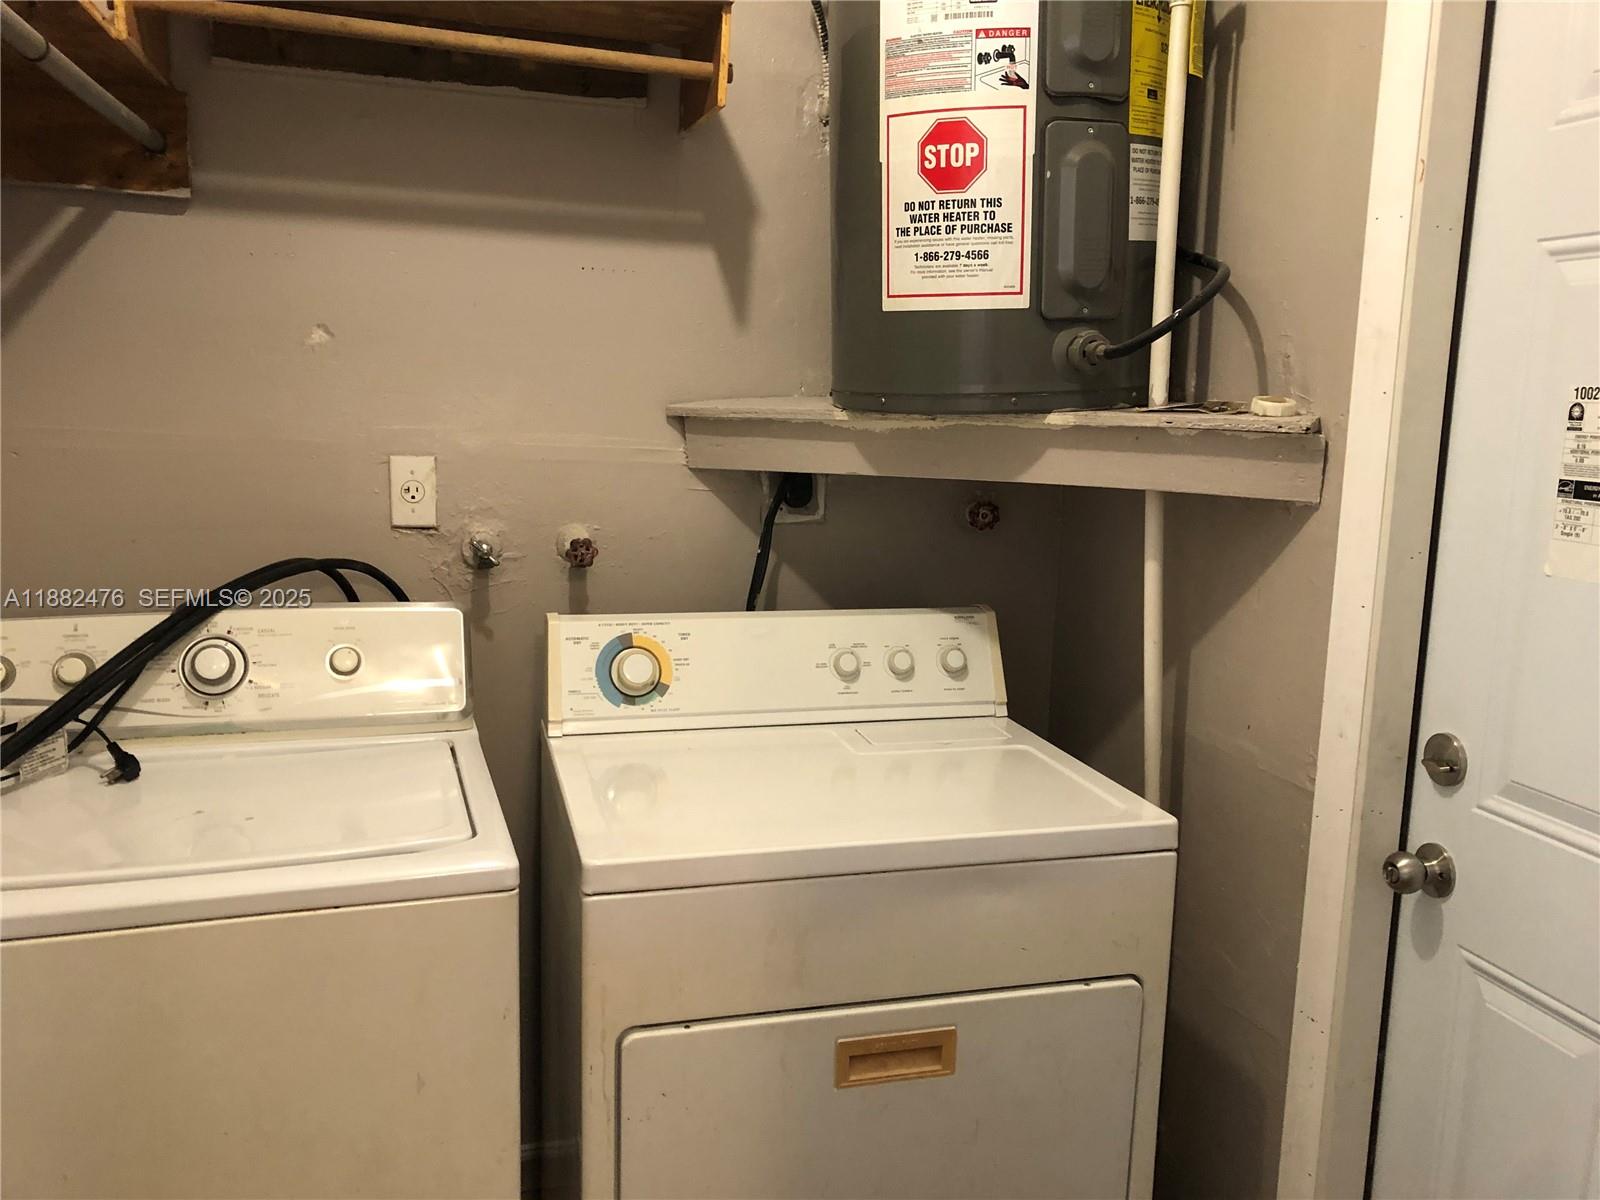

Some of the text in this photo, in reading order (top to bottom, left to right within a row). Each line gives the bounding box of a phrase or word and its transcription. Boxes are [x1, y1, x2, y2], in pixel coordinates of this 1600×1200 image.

[924, 142, 980, 170] STOP
[904, 198, 1002, 212] DO NOT RETURN THIS
[910, 210, 996, 224] WATER HEATER TO
[896, 223, 1013, 237] THE PLACE OF PURCHASE
[914, 250, 989, 262] 1-866-279-4566
